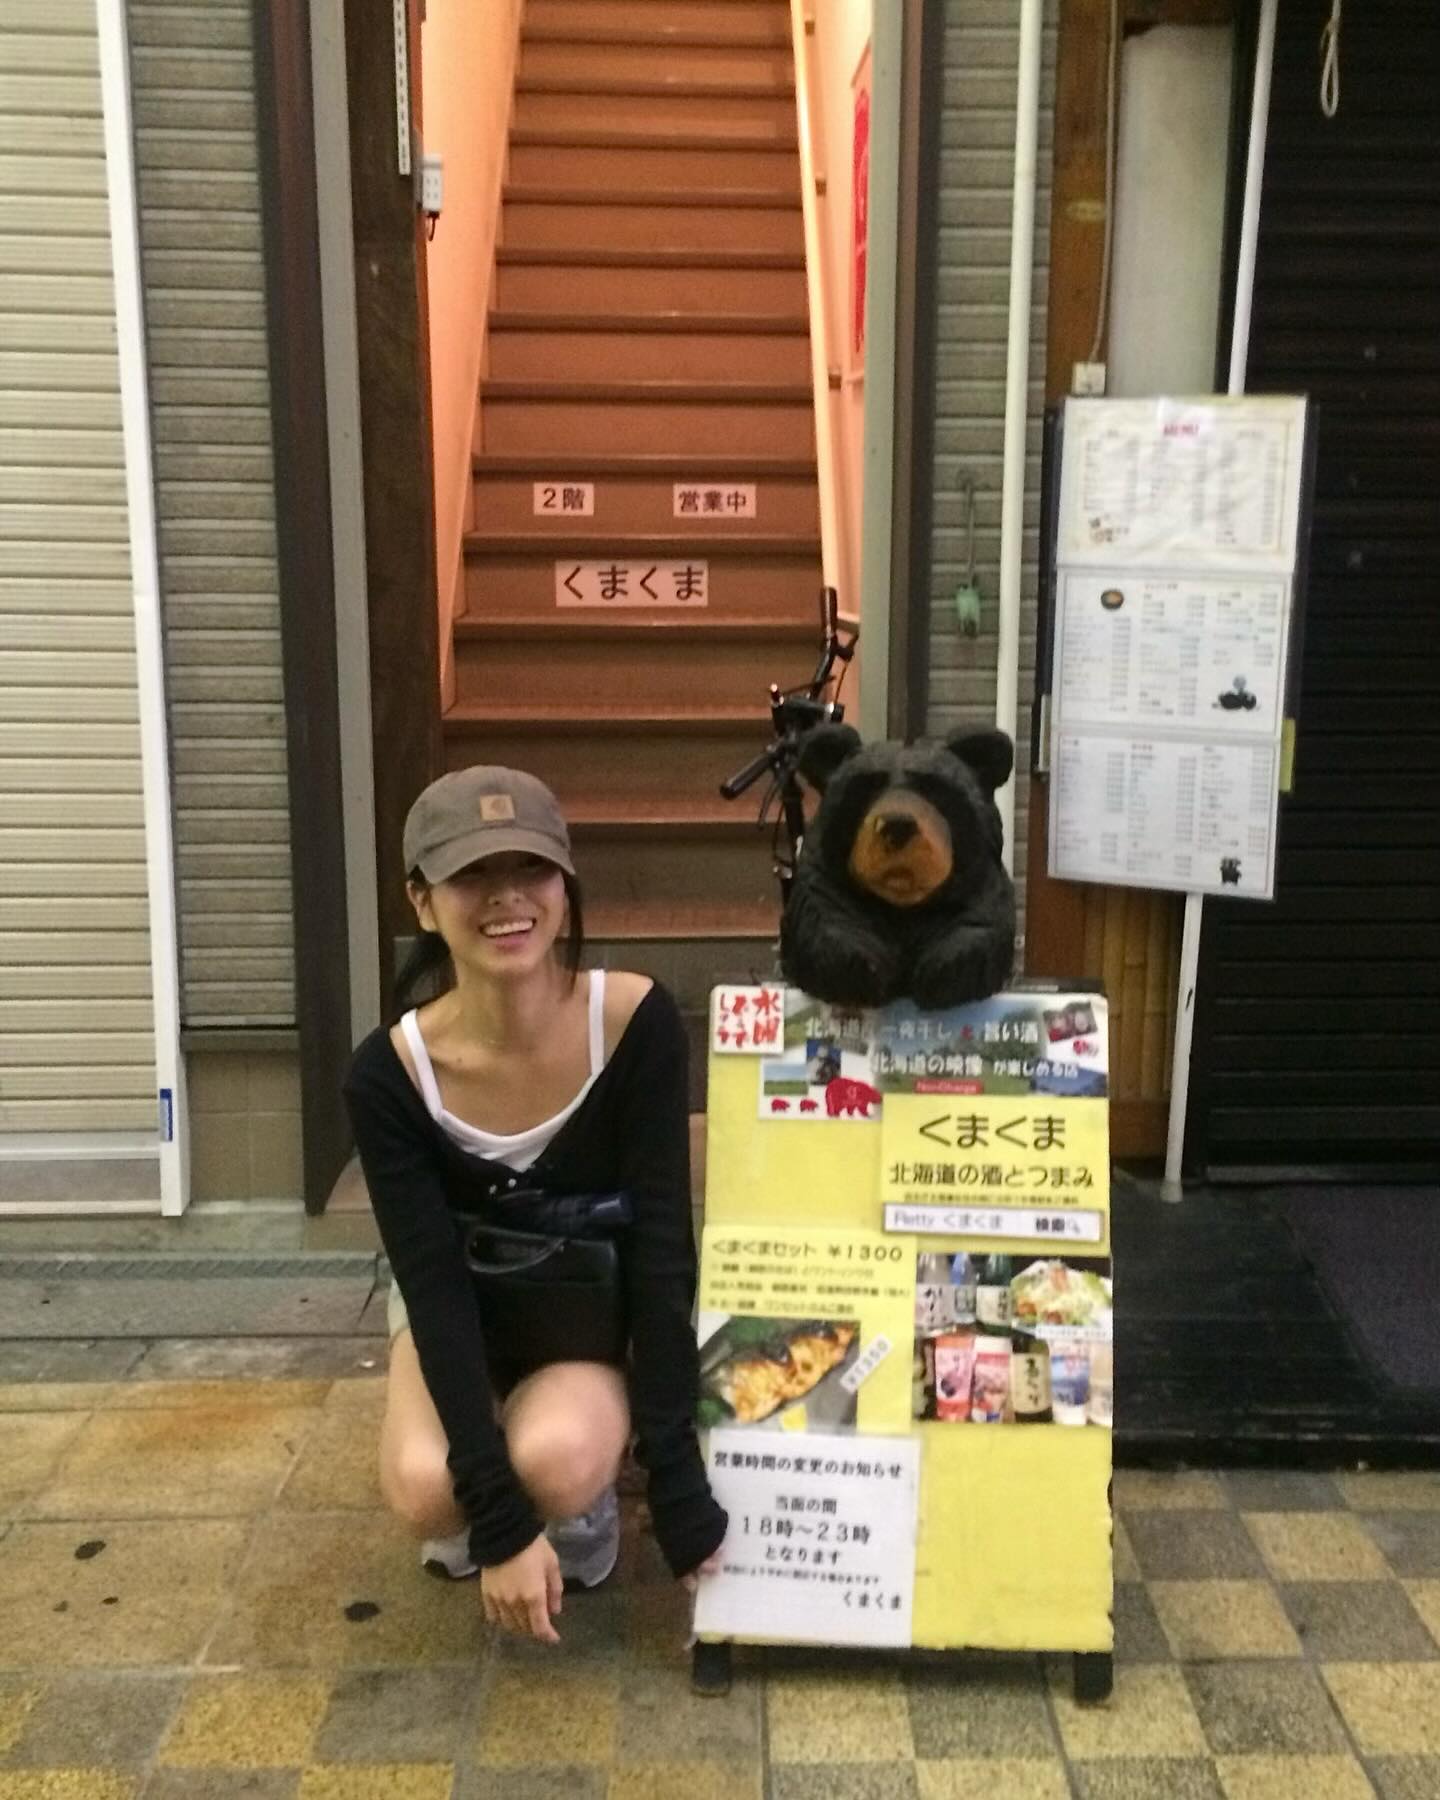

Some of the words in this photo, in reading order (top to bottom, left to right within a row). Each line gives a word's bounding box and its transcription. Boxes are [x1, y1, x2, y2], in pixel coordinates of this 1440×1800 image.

[542, 487, 586, 511] 2階
[677, 490, 748, 514] 営業中
[562, 564, 705, 602] くまくま
[918, 1114, 1067, 1150] くまくま
[889, 1162, 1094, 1189] 北海道の酒とつまみ
[711, 1238, 818, 1259] くまくまセット
[828, 1244, 903, 1262] ¥1300
[714, 1451, 903, 1479] 営業時間の変更のお知らせ
[775, 1495, 838, 1515] 当面の間
[765, 1544, 841, 1566] となります
[842, 1590, 902, 1610] くまくま
